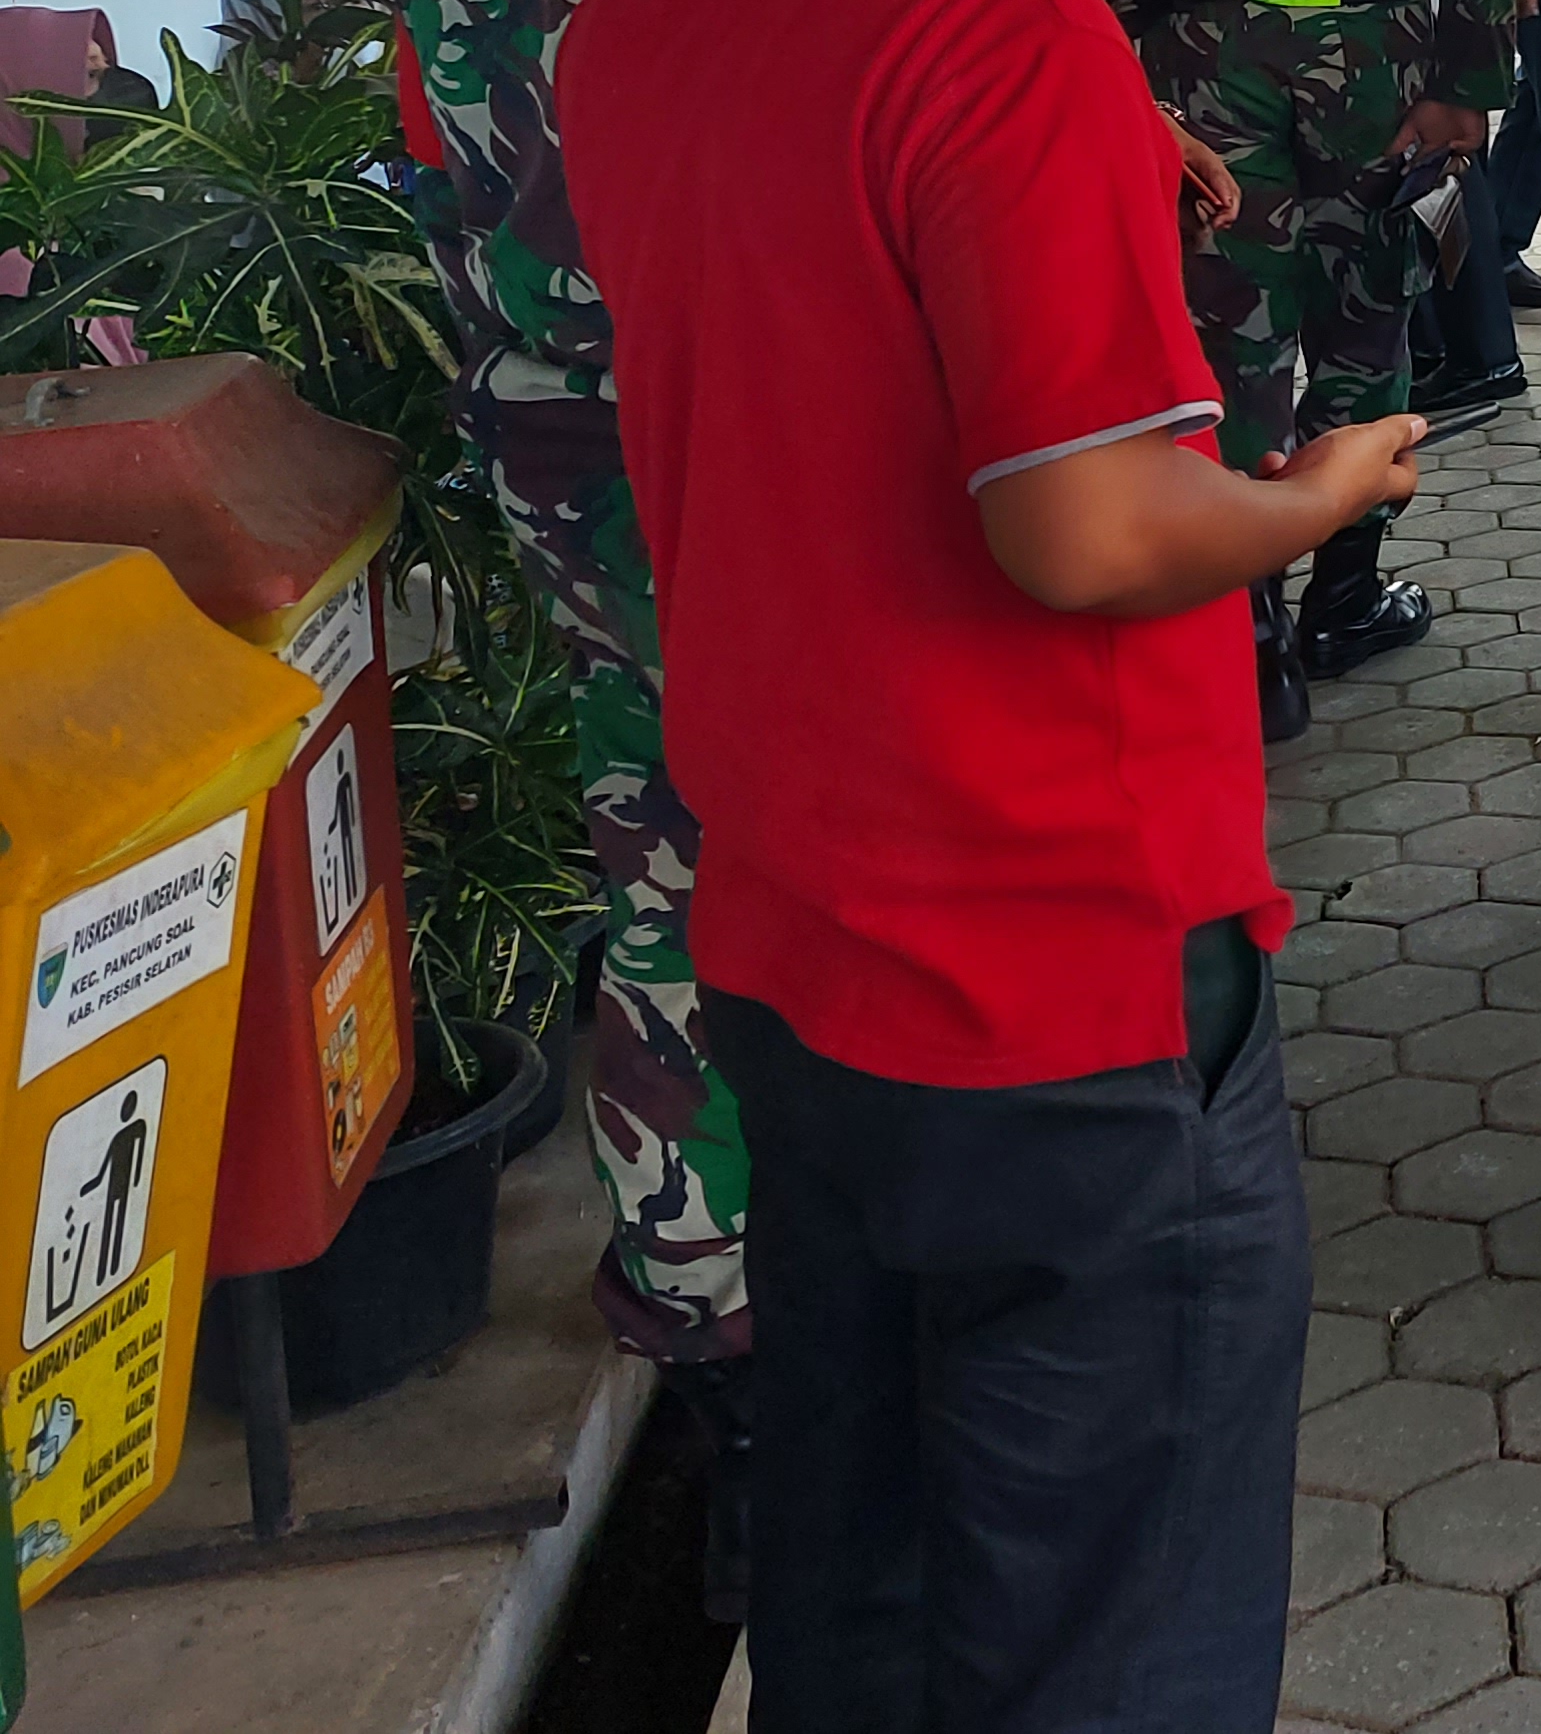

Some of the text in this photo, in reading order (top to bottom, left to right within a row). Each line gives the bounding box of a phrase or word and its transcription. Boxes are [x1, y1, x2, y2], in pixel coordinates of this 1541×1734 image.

[72, 863, 205, 959] PUSKESMAS INDERAPURA
[67, 943, 192, 1028] KAB. PESISIR SELATAN
[70, 916, 195, 998] KEC. PANCUNG SOAL
[17, 1277, 150, 1403] SAMPAH GUNA ULANG
